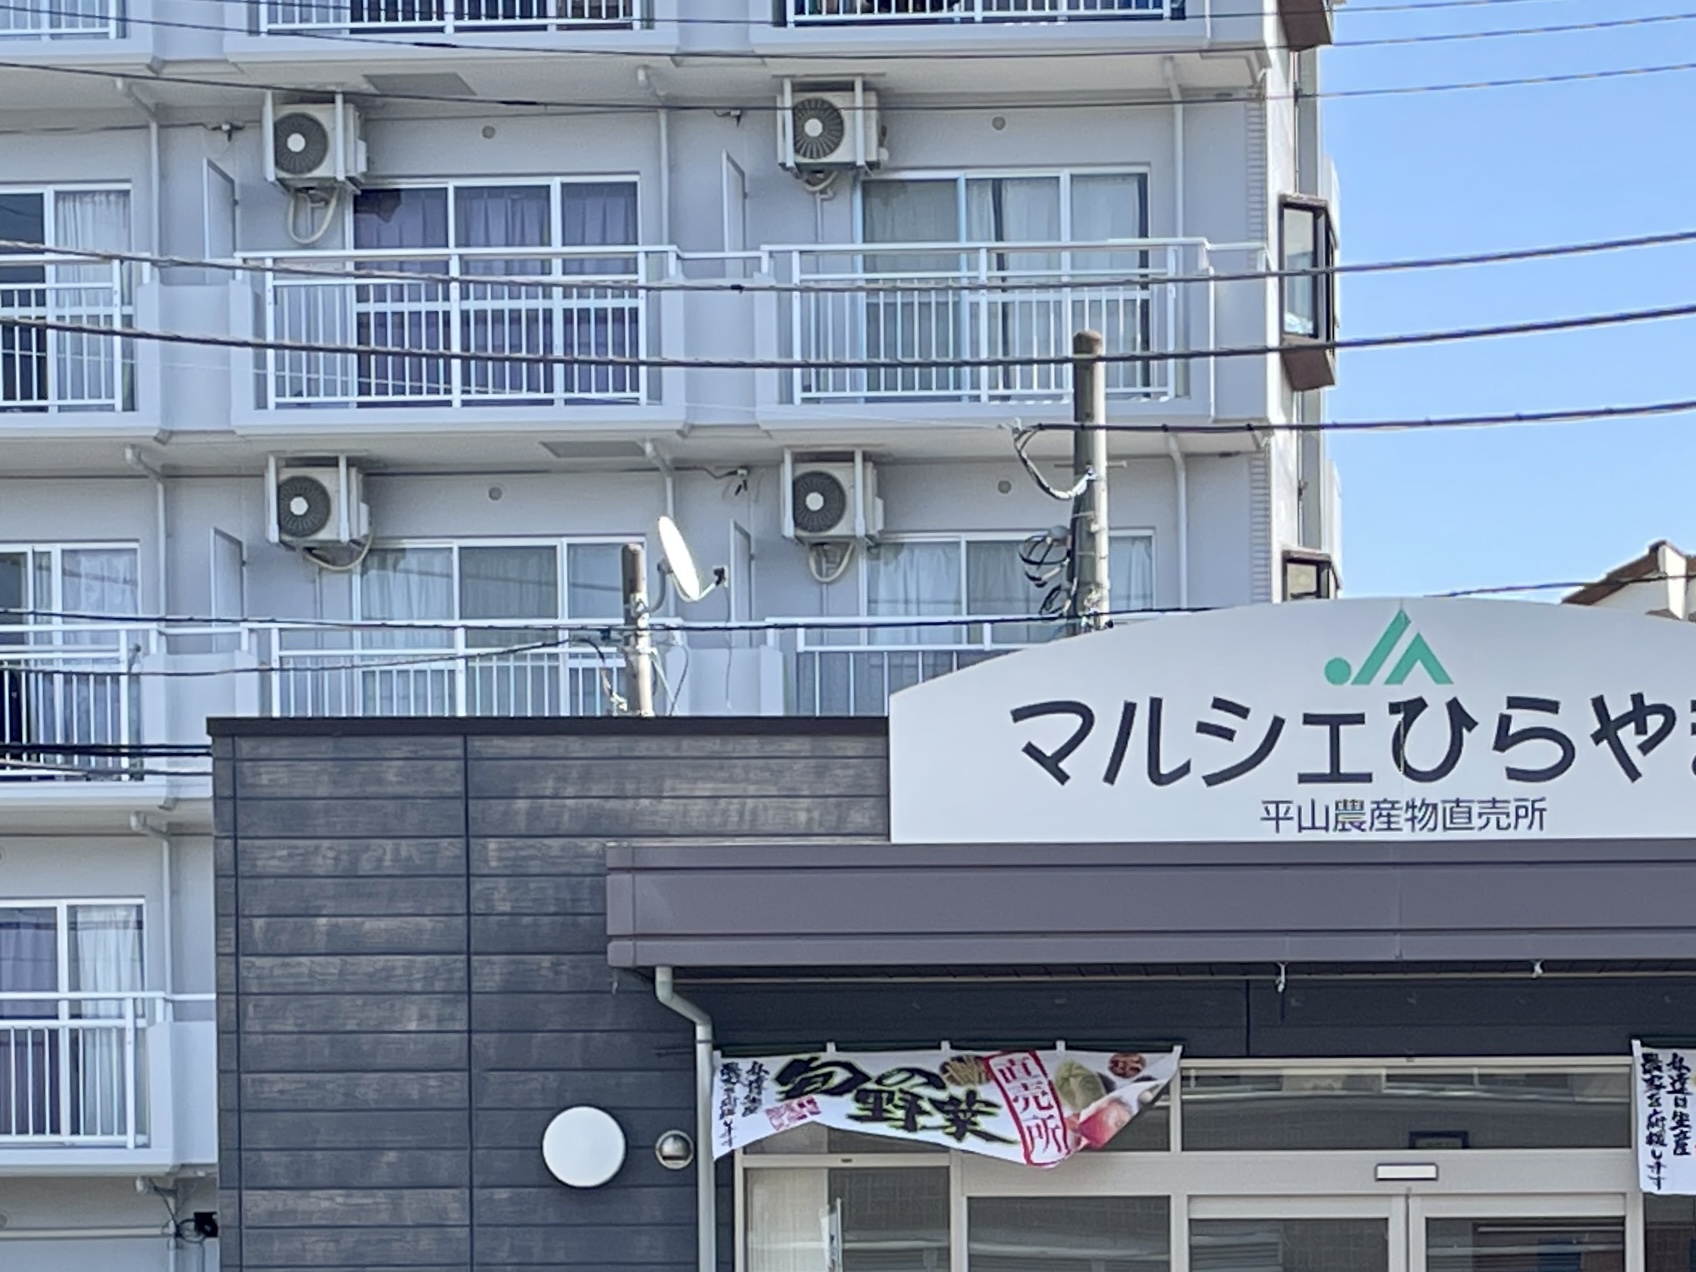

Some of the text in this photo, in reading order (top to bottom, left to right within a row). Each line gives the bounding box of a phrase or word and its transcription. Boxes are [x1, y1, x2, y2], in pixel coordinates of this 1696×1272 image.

[1260, 797, 1548, 834] 平山農産物直売所
[997, 1055, 1068, 1157] 直売所
